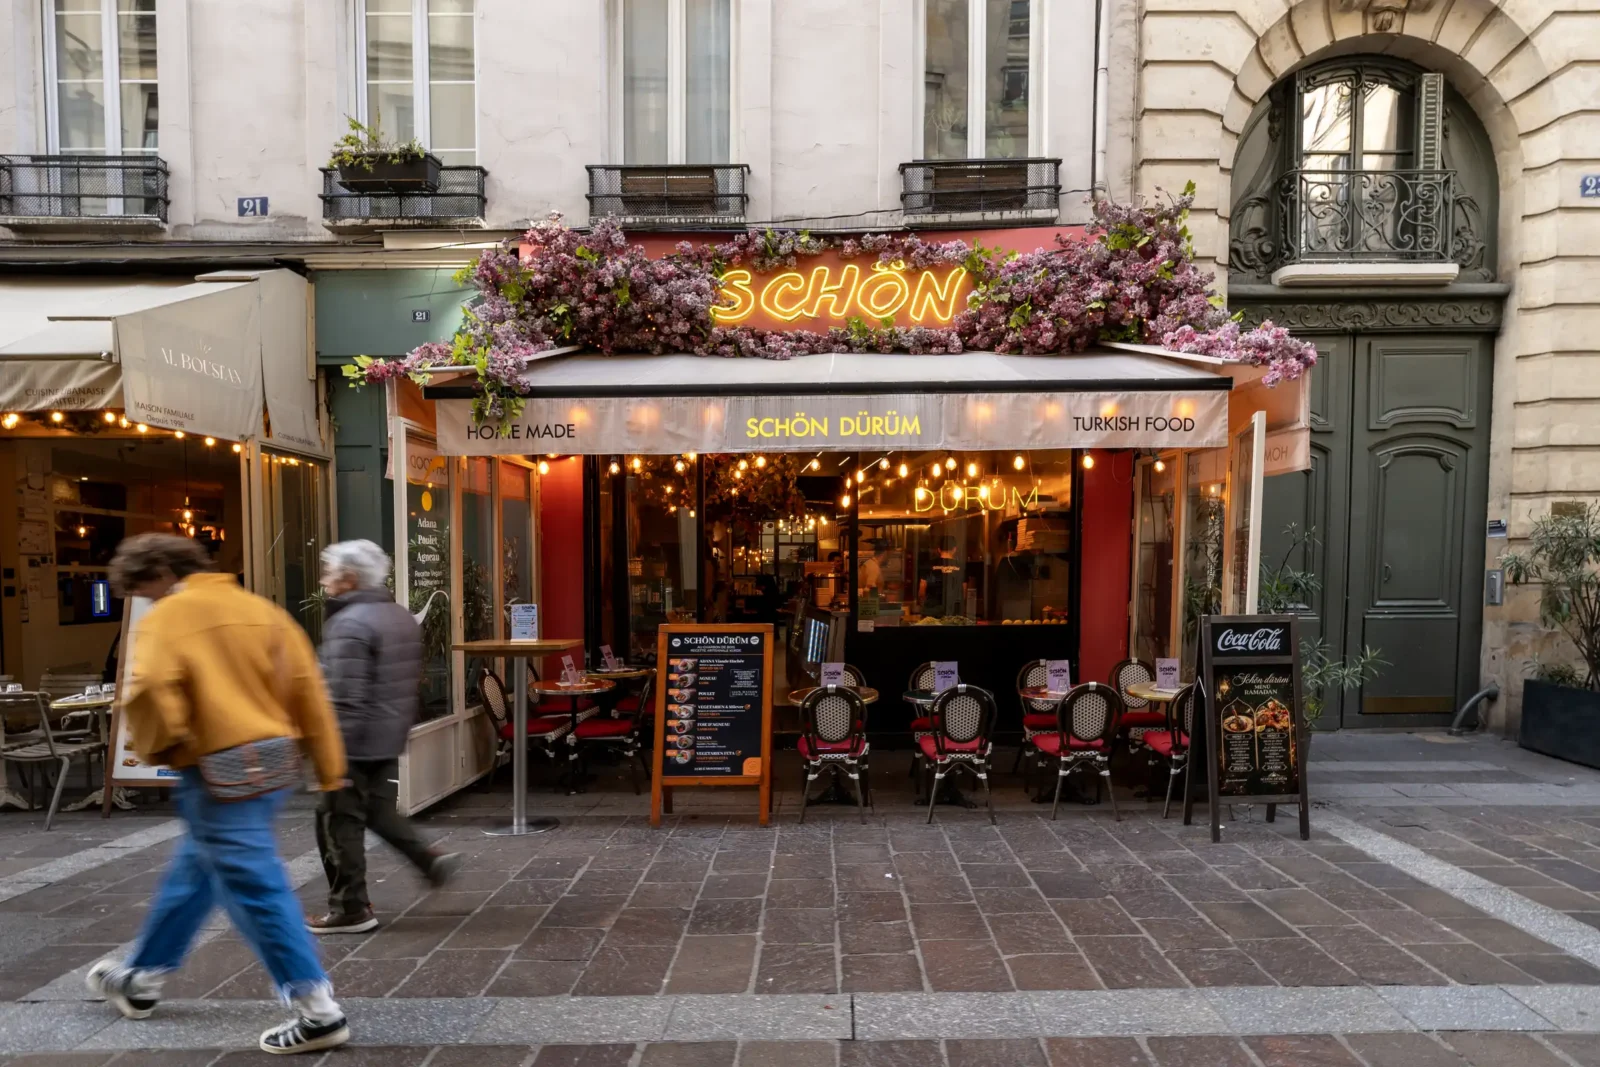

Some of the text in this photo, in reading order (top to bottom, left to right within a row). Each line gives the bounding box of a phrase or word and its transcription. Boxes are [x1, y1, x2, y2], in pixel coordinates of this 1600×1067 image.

[1585, 176, 1600, 195] 2
[242, 199, 262, 216] 21
[709, 259, 966, 322] SCHÖN
[415, 311, 426, 320] 21
[163, 407, 195, 421] FAMILIALE
[526, 423, 575, 439] MADE
[746, 410, 921, 438] SCHÖN DÜRÜM
[1073, 416, 1195, 432] TURKISH FOOD
[417, 517, 437, 528] Adana
[417, 534, 438, 545] Poulet
[416, 552, 440, 564] Agneau
[684, 635, 715, 645] SCHÖN
[716, 635, 749, 645] DÜRÜM
[1217, 628, 1284, 651] Coca-Cola
